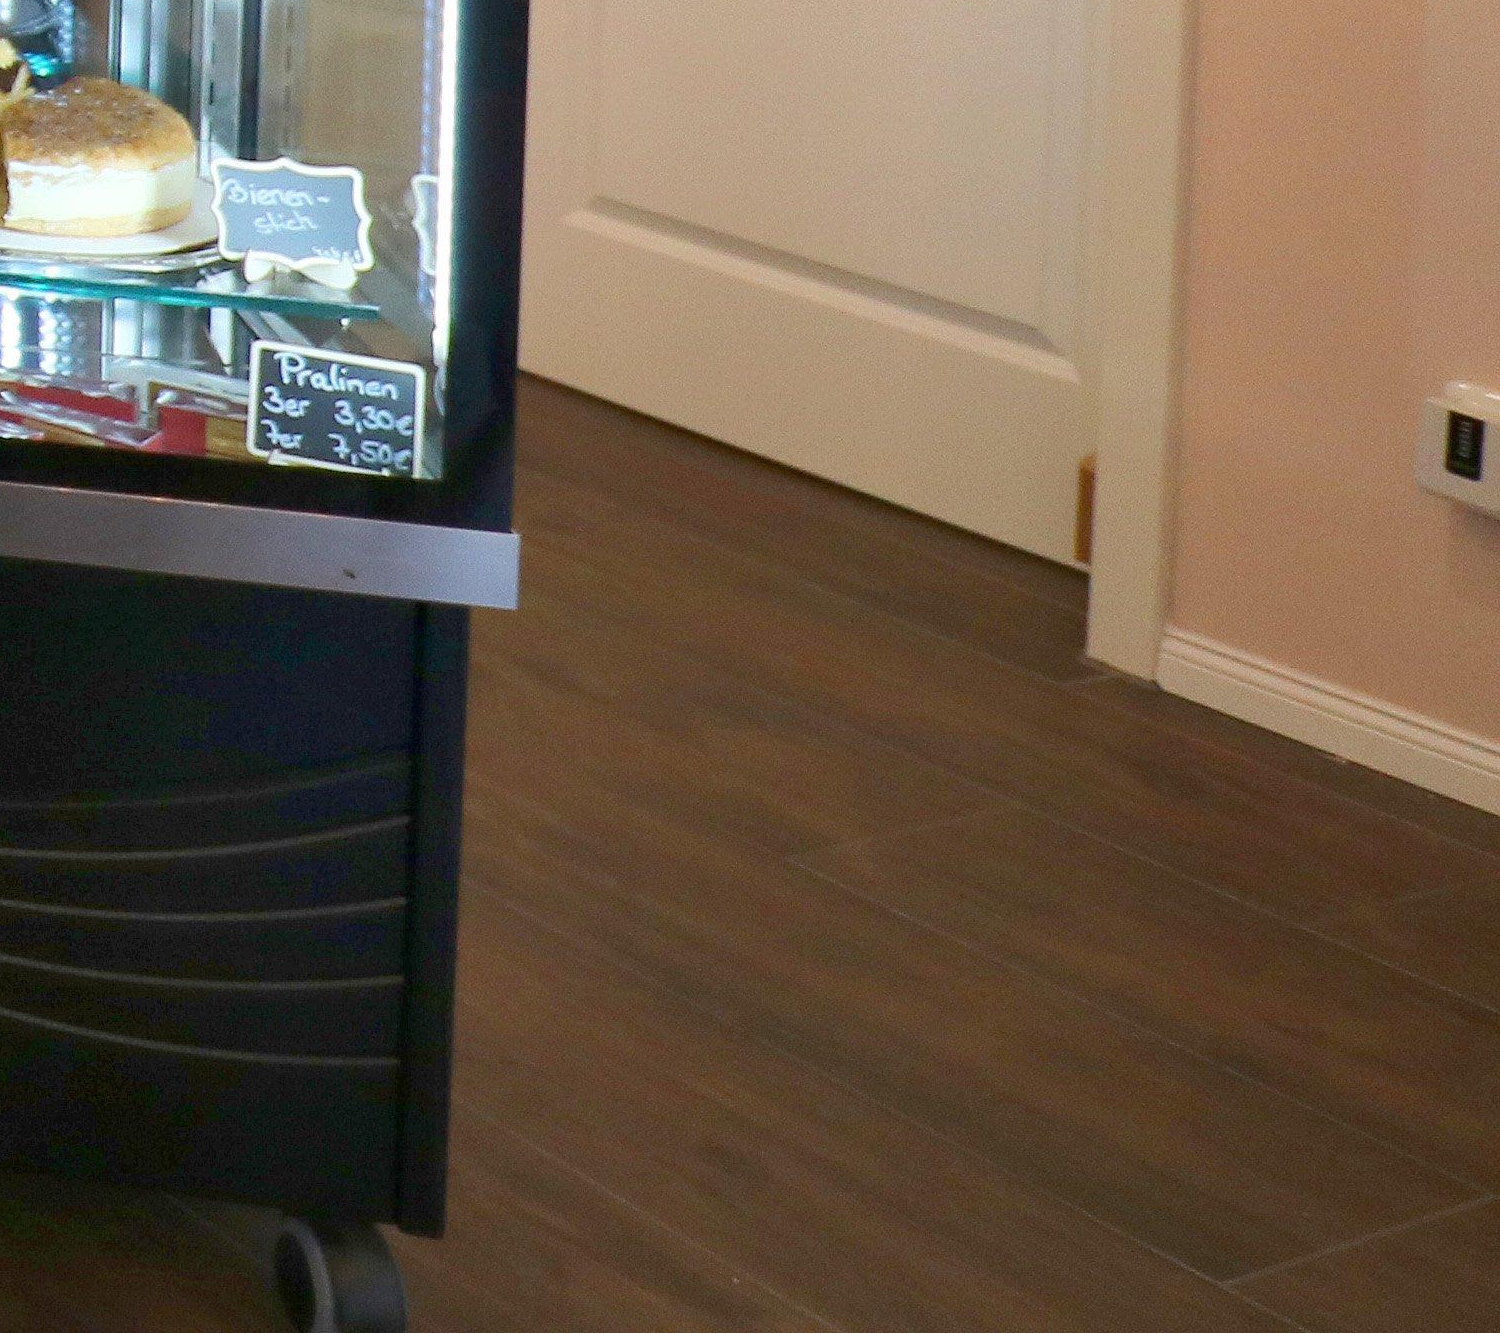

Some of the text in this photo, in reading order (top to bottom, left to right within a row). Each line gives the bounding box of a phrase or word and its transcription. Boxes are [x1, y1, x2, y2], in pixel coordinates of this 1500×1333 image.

[272, 351, 399, 401] Pralinen
[262, 385, 312, 419] 3er
[260, 419, 304, 449] 7er
